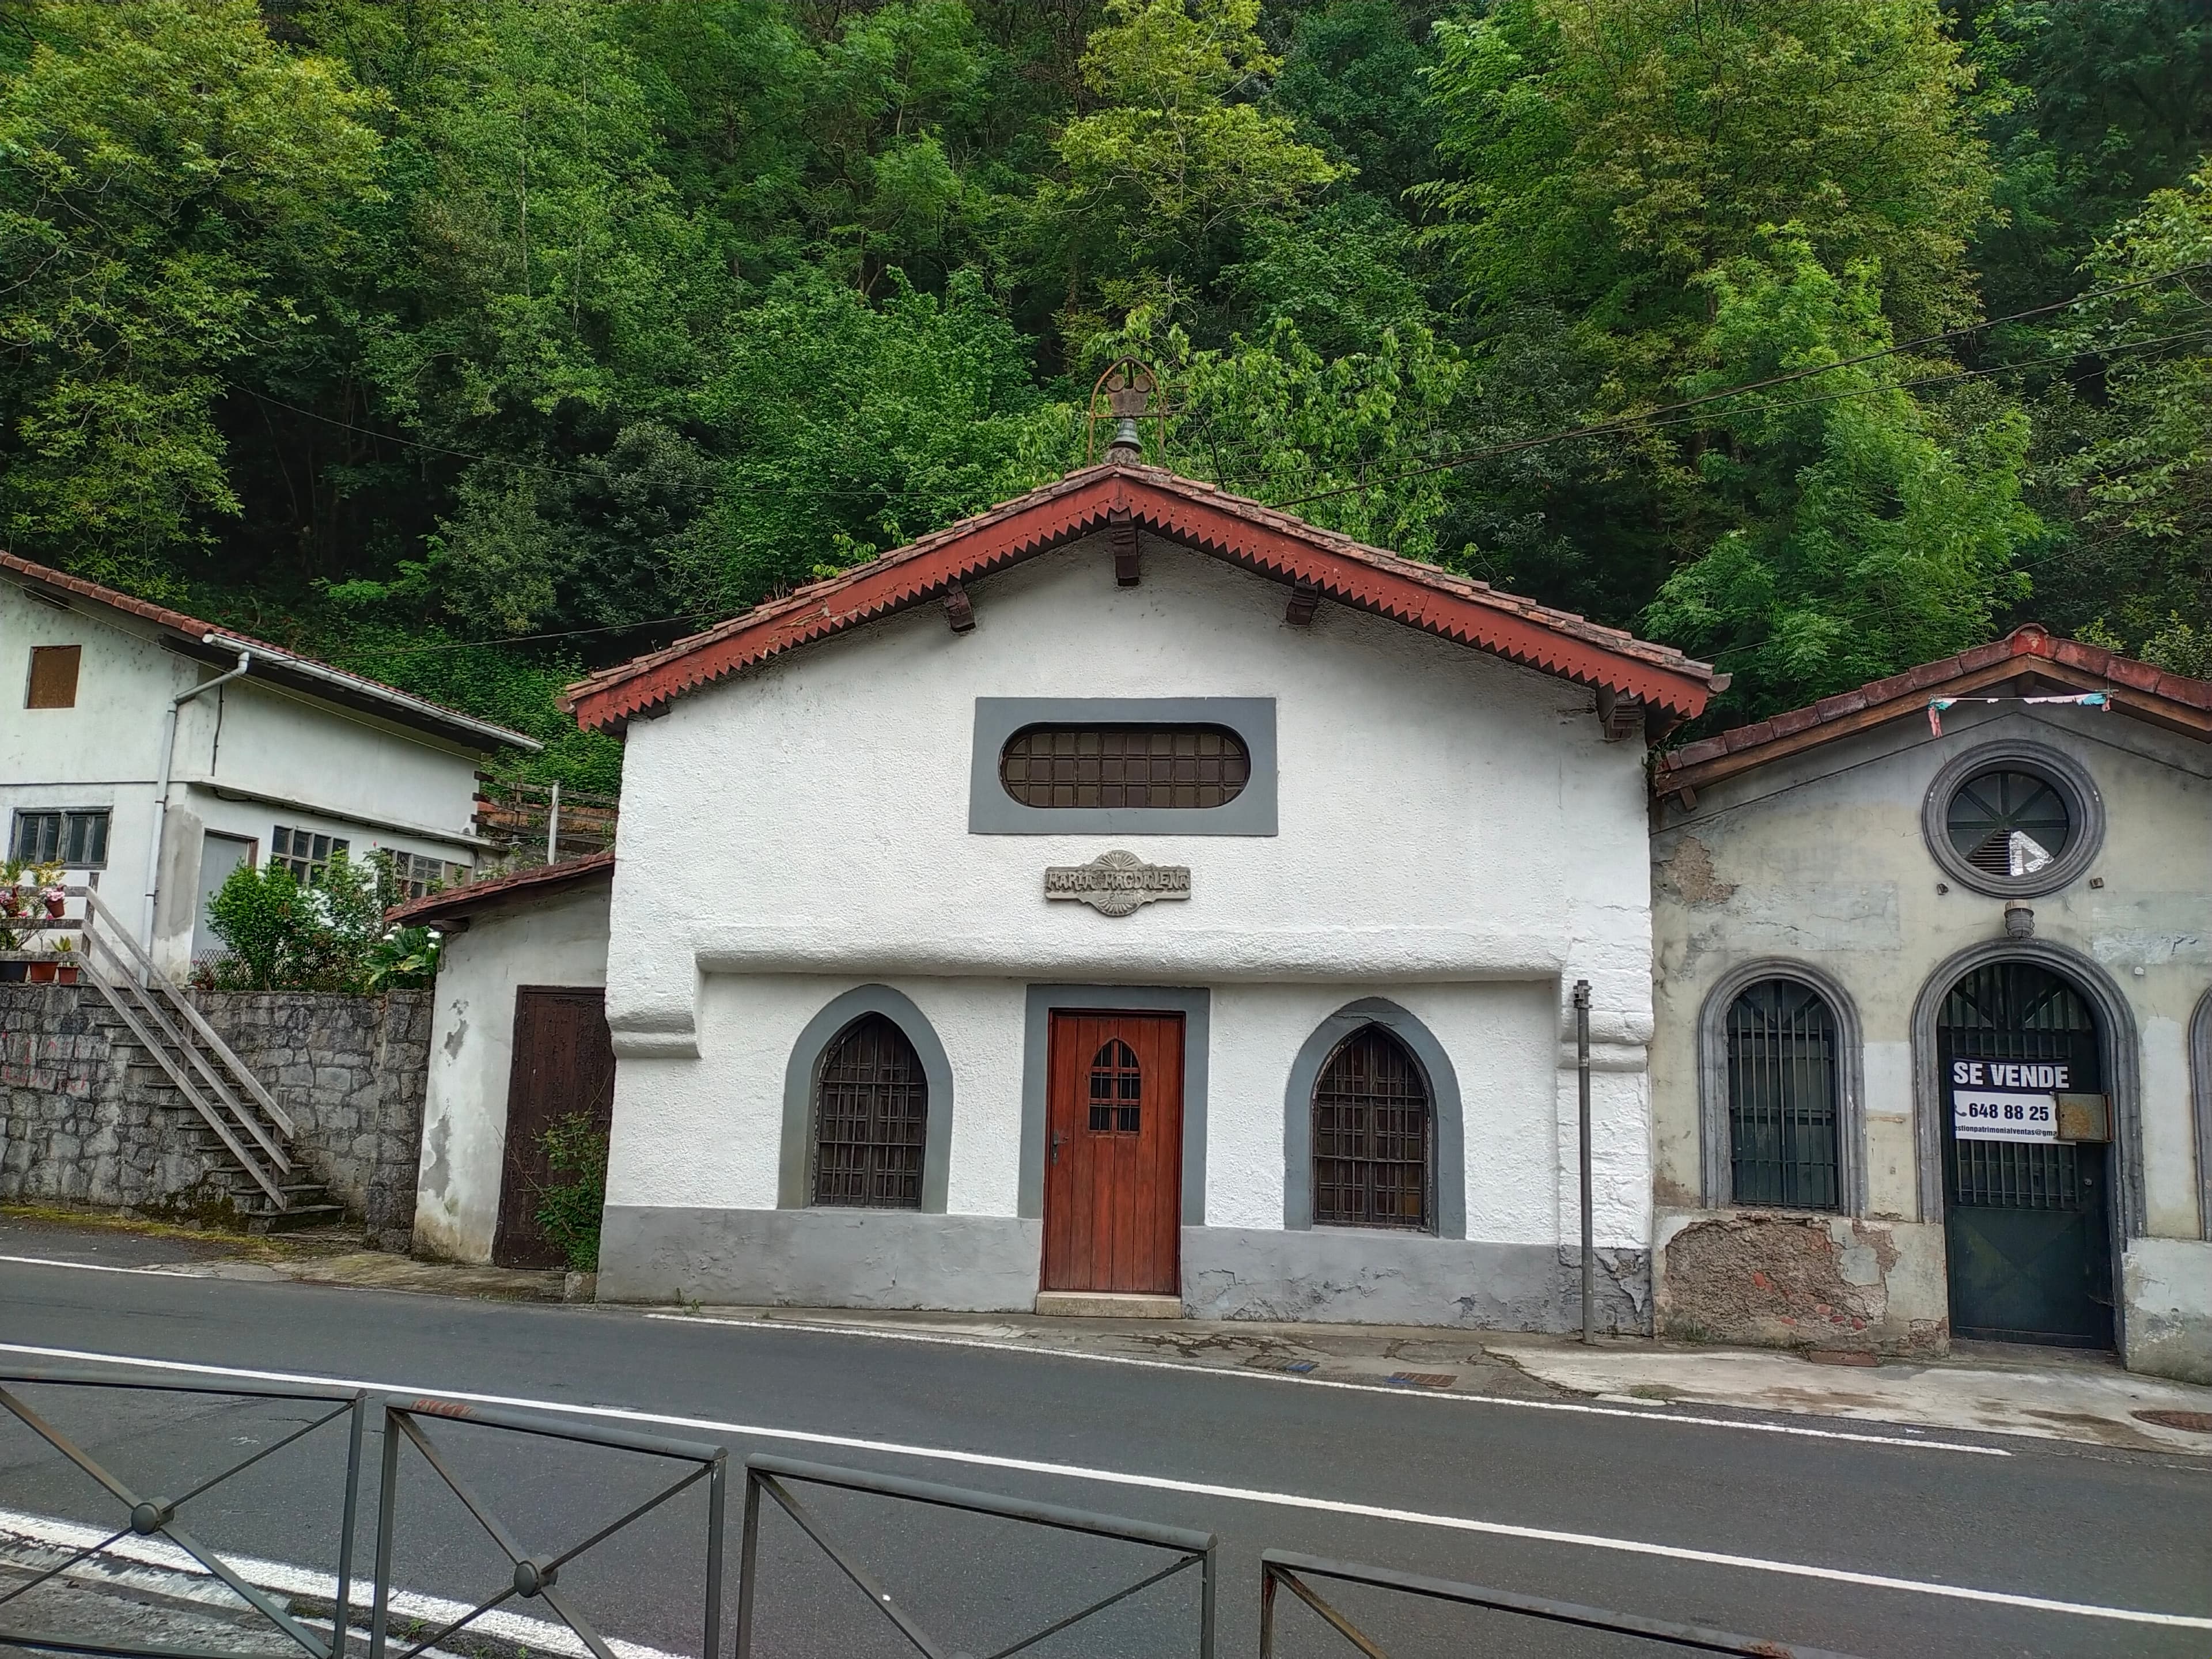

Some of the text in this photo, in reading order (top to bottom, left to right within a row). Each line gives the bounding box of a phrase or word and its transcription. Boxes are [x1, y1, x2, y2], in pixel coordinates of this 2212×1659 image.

[1104, 871, 1190, 890] MAGDALENA
[1953, 1062, 2069, 1088] SE VENDE
[1969, 1103, 2049, 1121] 648 88 25
